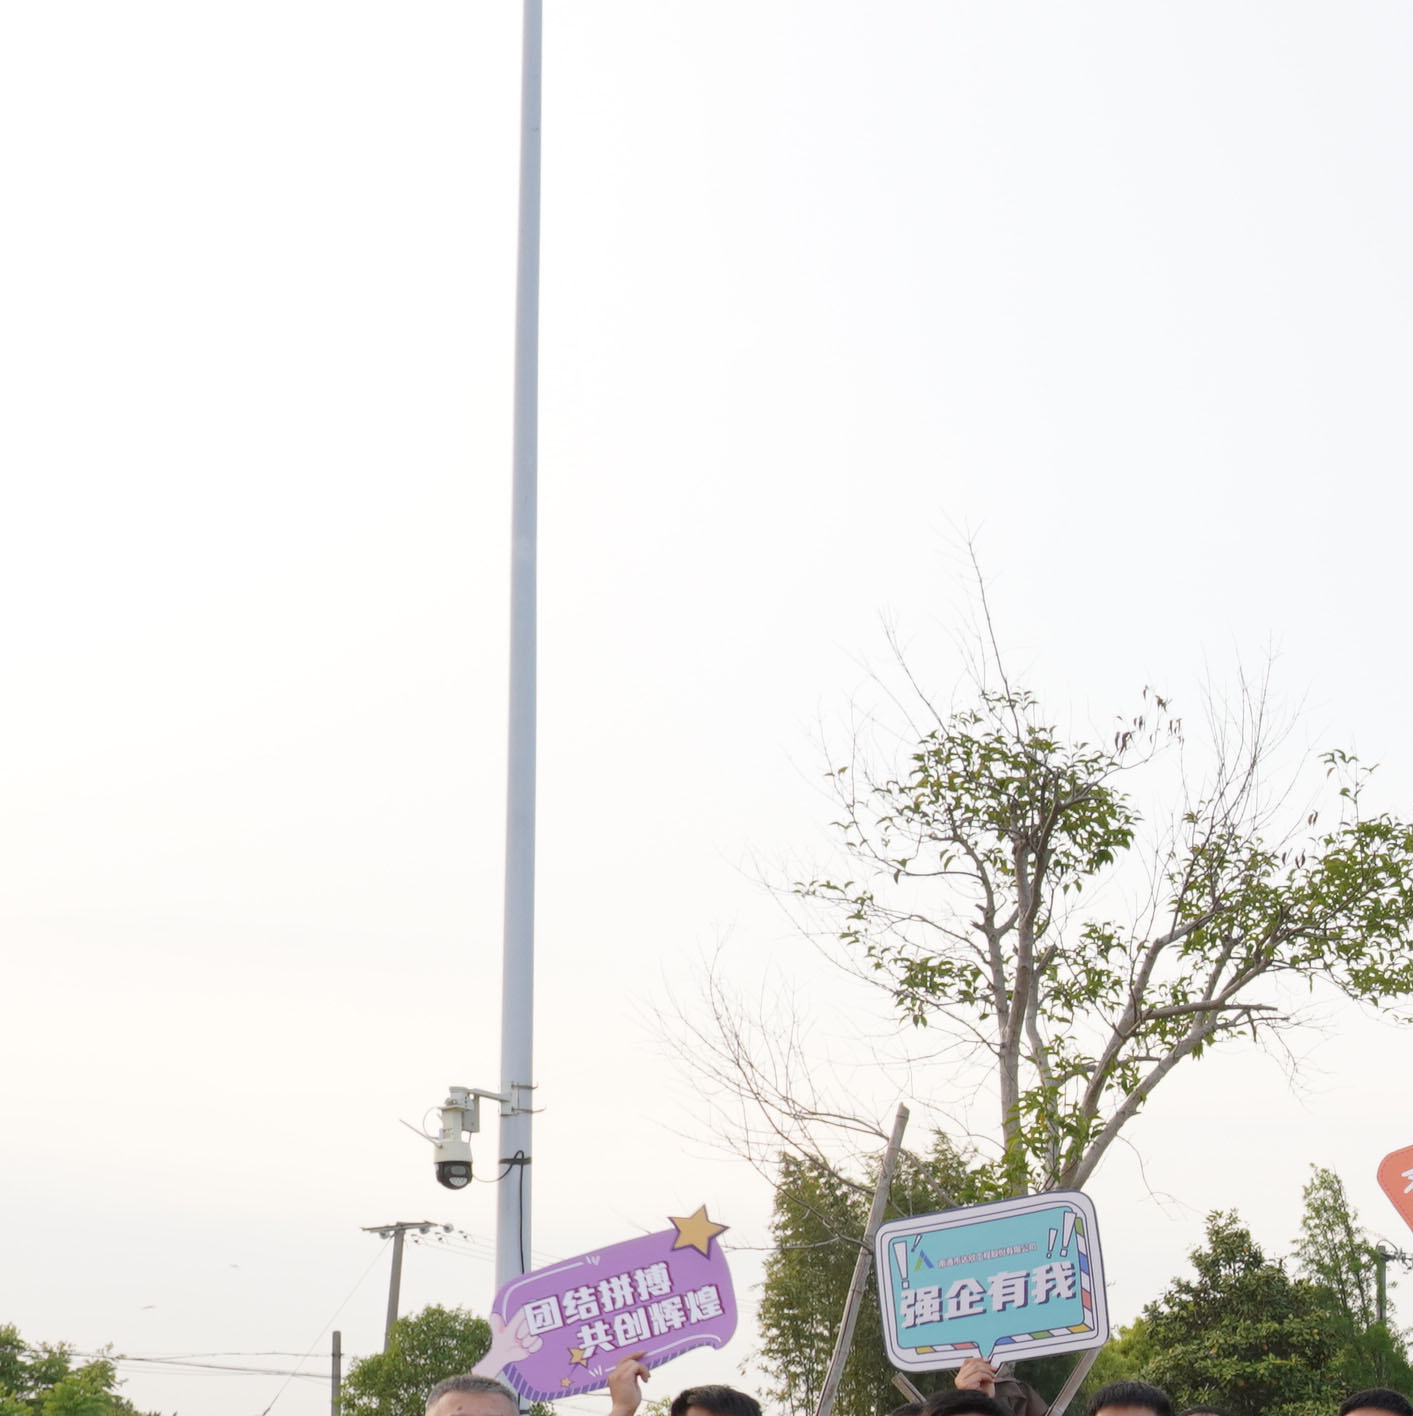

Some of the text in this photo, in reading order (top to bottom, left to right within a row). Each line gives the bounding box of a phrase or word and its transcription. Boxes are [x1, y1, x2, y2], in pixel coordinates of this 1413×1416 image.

[523, 1261, 673, 1336] 团结拼搏
[577, 1284, 724, 1358] 共创辉煌
[901, 1261, 1076, 1329] 强企有我
